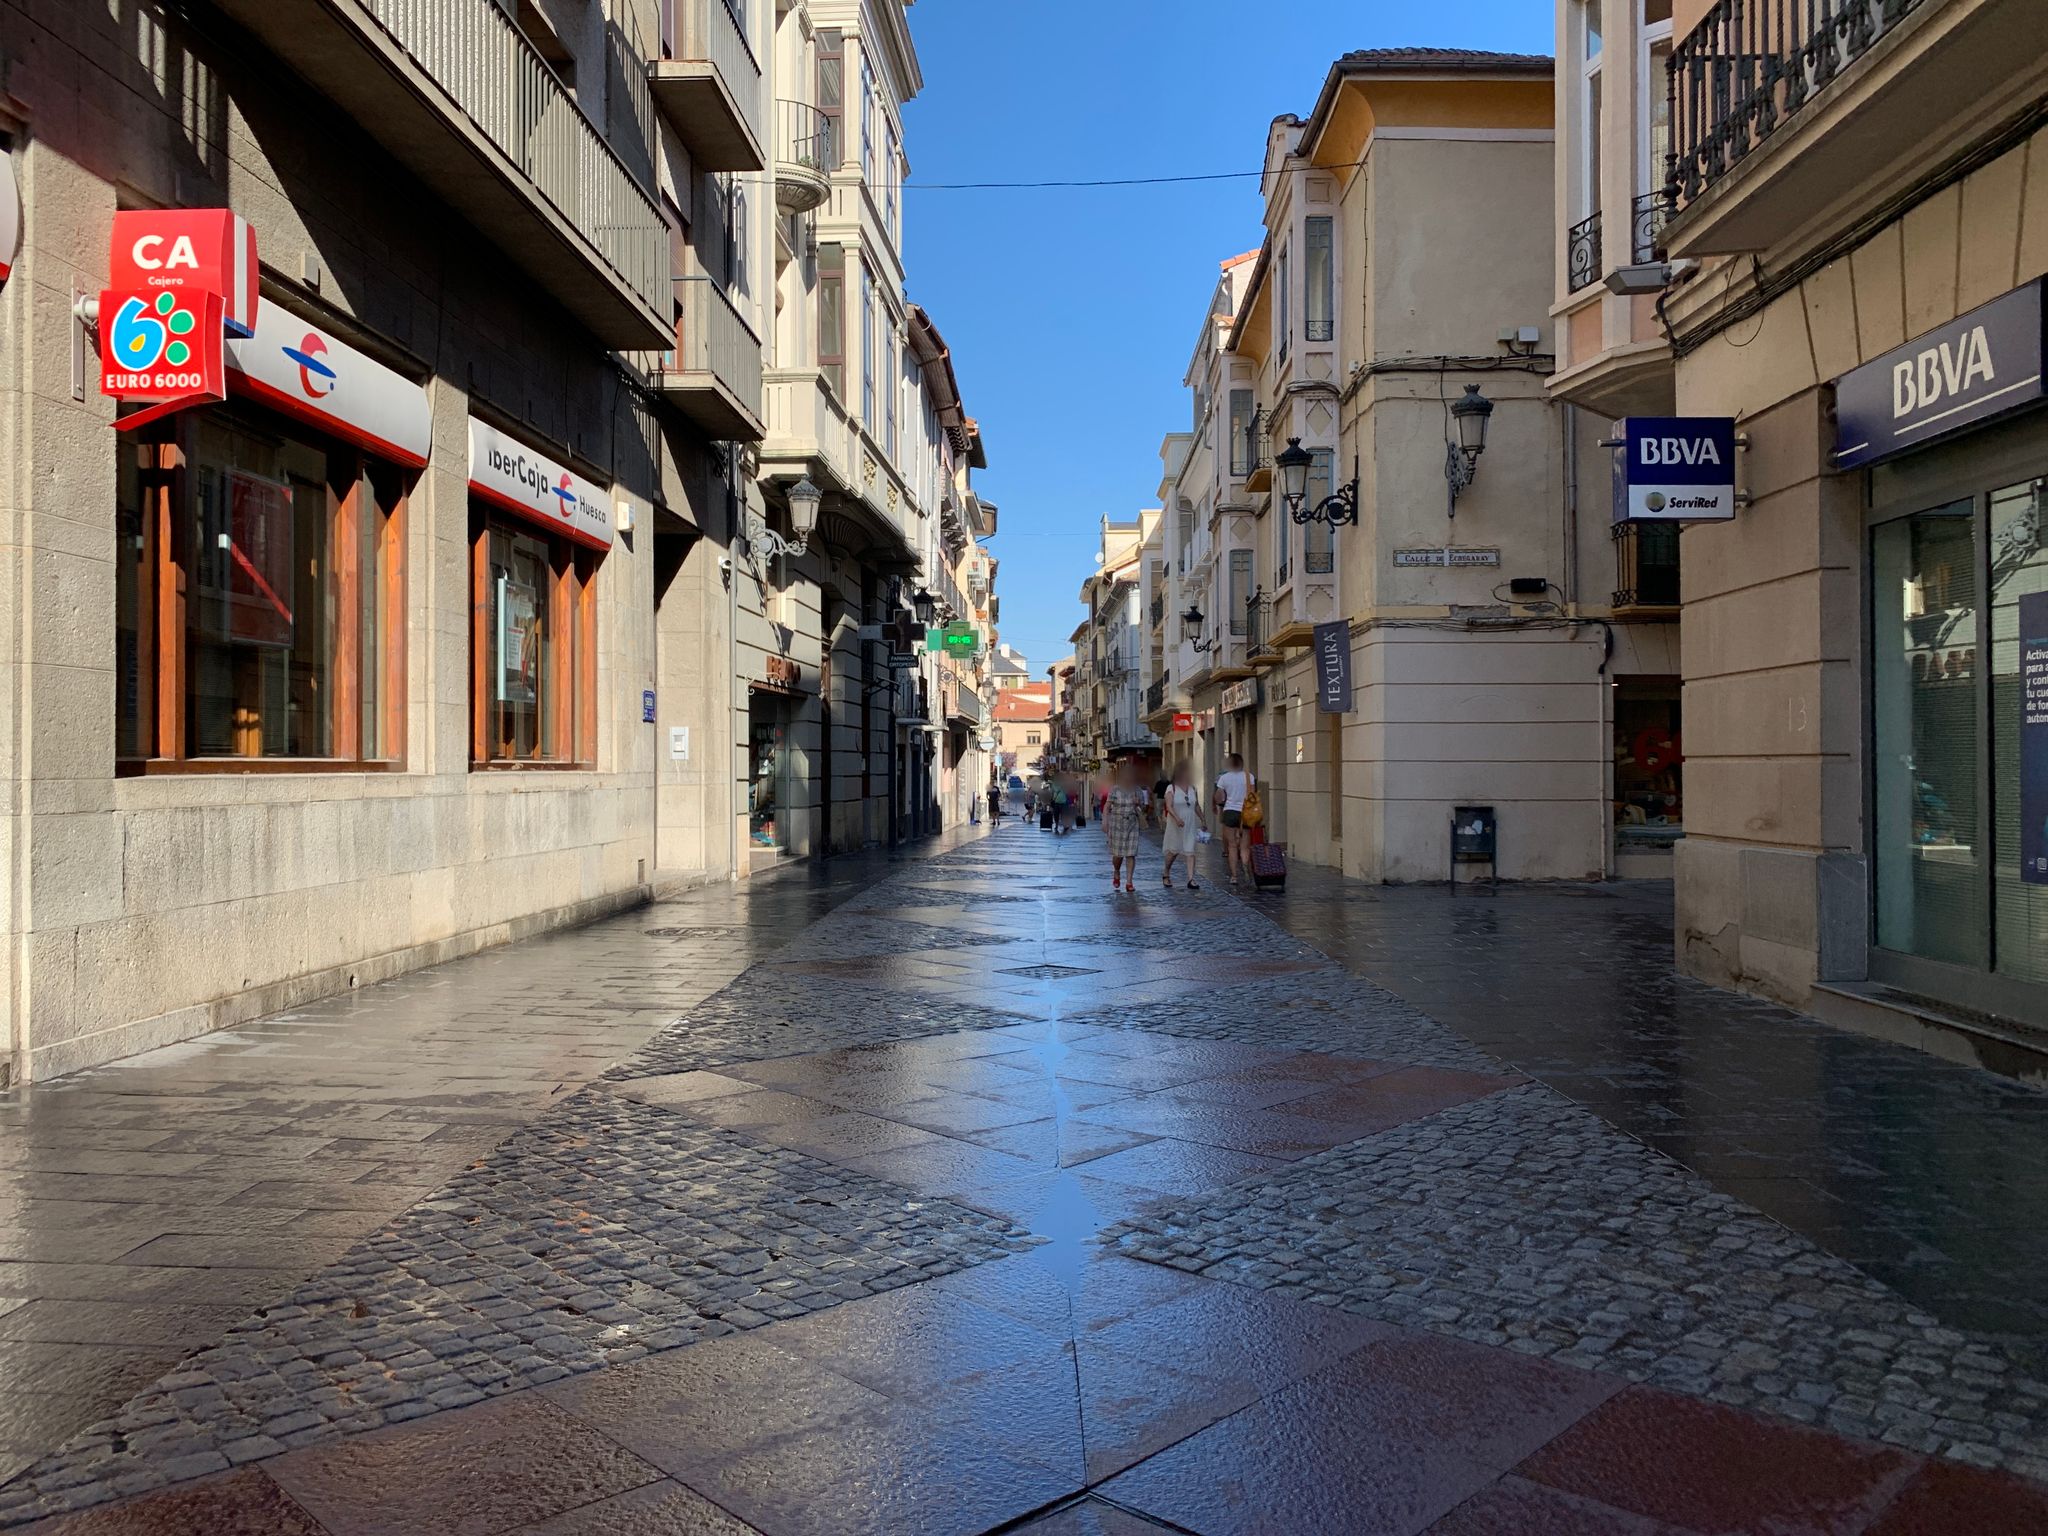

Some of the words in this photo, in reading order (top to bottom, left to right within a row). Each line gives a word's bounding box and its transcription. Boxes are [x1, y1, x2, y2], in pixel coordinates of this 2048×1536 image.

[132, 235, 199, 270] CA
[147, 276, 184, 287] Cajero
[1894, 325, 1995, 419] BBVA
[106, 374, 151, 389] EURO
[155, 373, 201, 388] 6000
[1640, 437, 1721, 465] BBVA
[579, 495, 607, 524] Huesca
[1669, 496, 1719, 509] ServiRed
[1323, 632, 1341, 705] TEXTURA
[2026, 664, 2043, 676] para
[2026, 679, 2031, 689] y
[2026, 690, 2035, 698] tu
[2026, 701, 2036, 711] de
